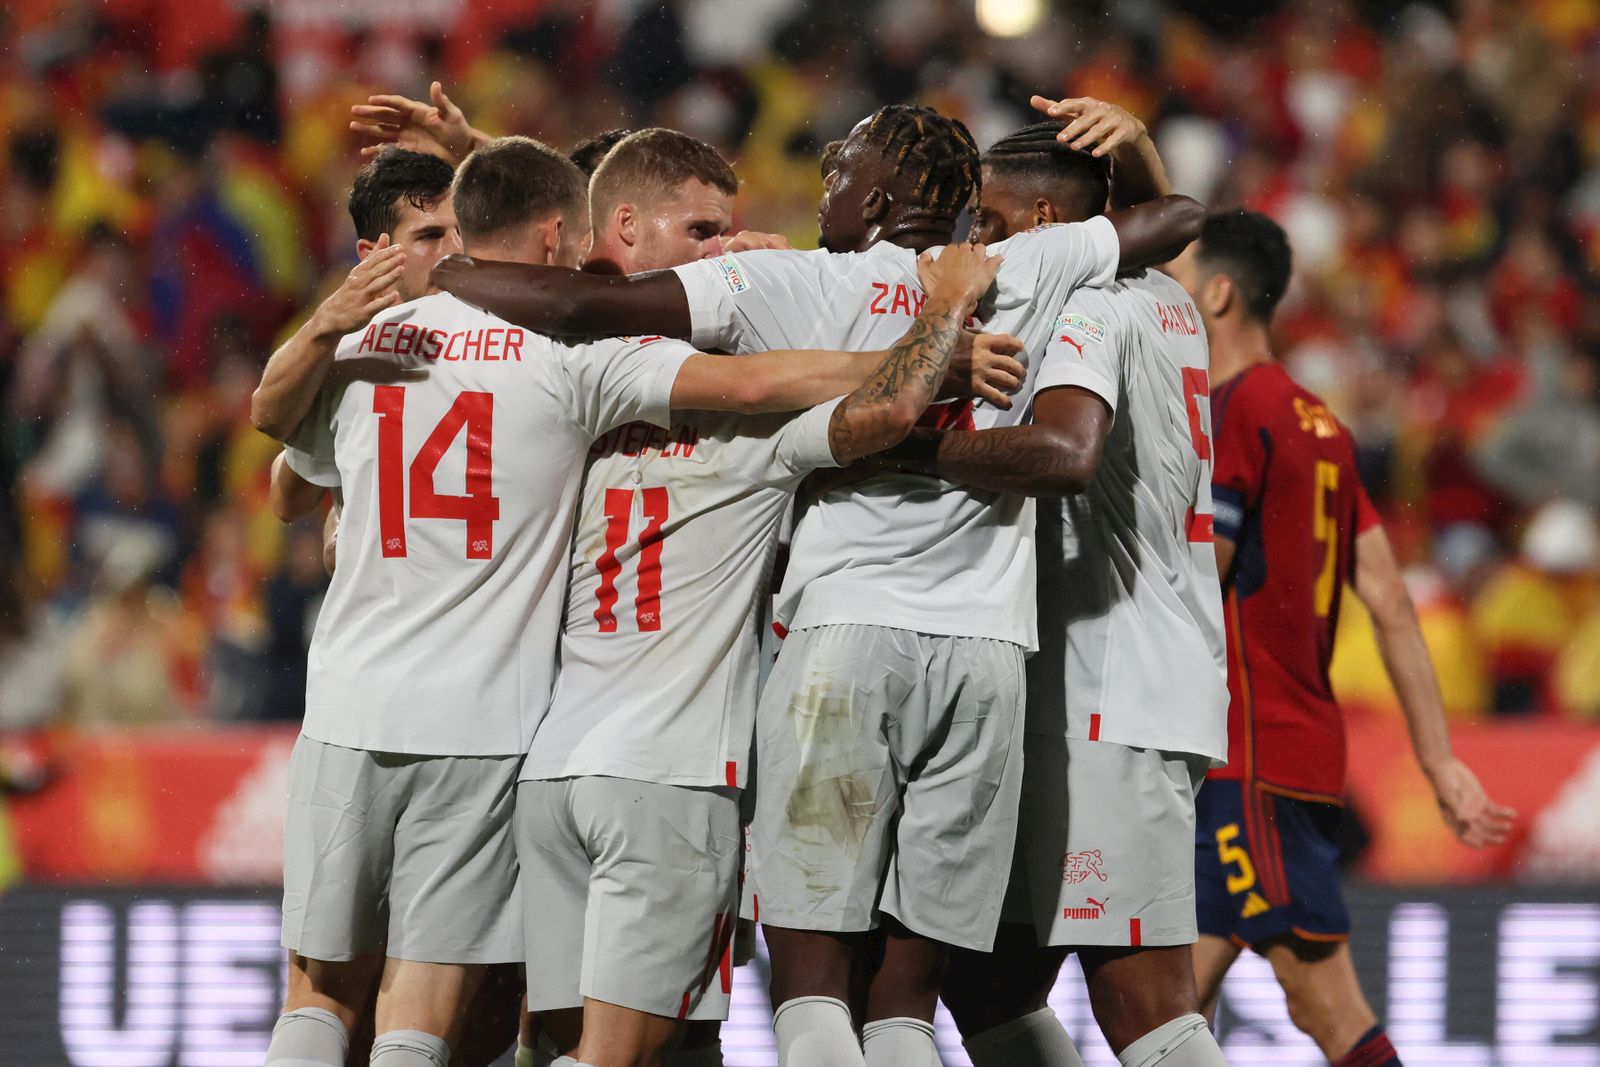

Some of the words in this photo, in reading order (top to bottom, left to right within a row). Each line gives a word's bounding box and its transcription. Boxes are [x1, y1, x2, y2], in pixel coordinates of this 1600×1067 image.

[870, 282, 928, 318] ZAK
[357, 322, 525, 361] AEBISCHER
[373, 385, 499, 560] 14
[594, 487, 669, 632] 11
[1215, 823, 1255, 894] 5
[1063, 907, 1099, 920] PUMA
[60, 900, 288, 1067] UE
[1386, 902, 1600, 1067] LE
